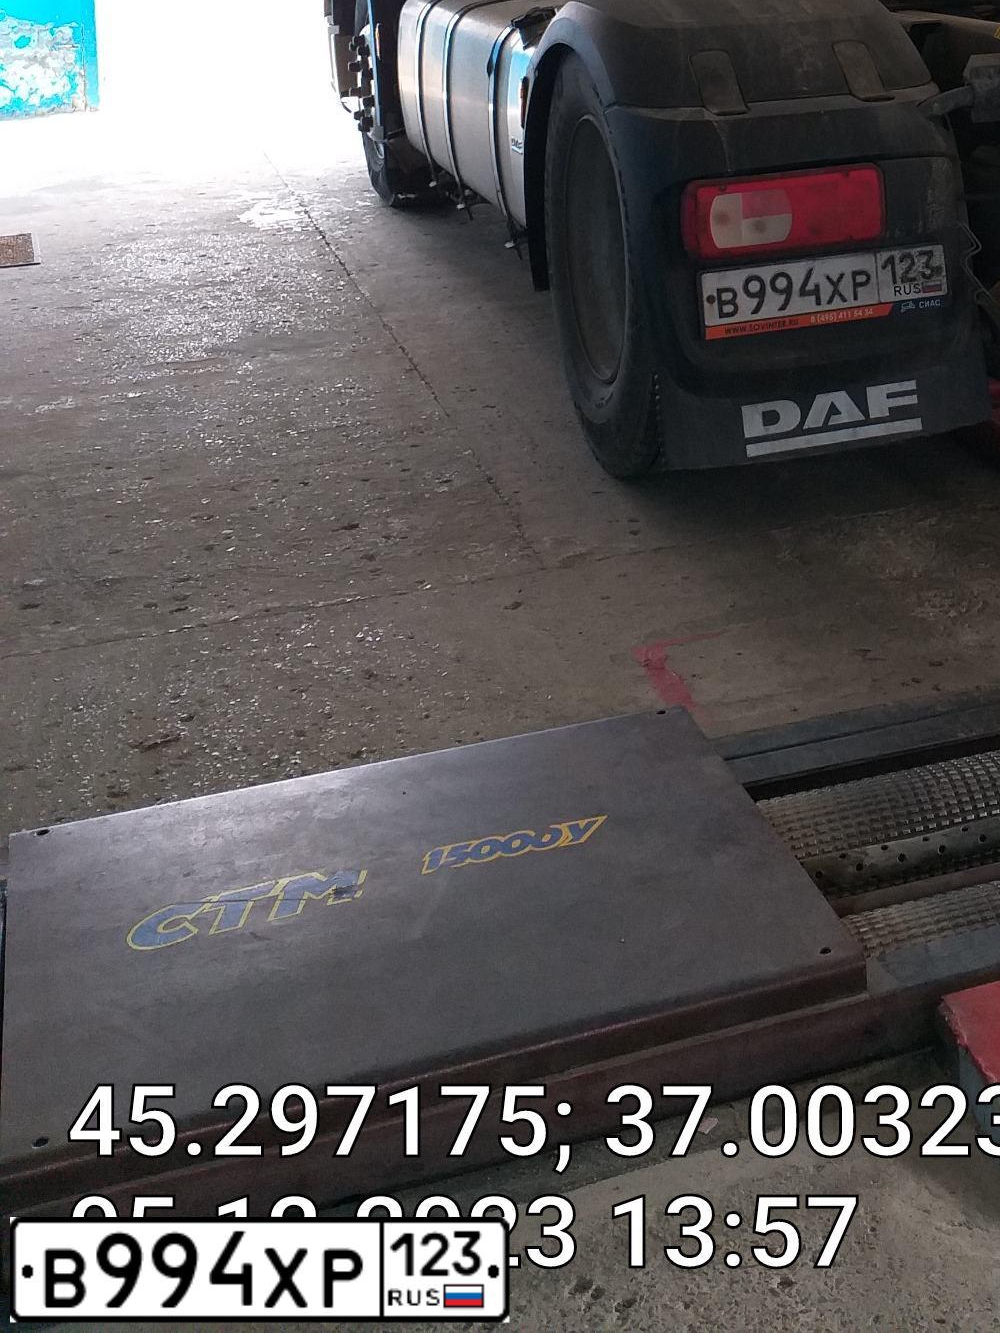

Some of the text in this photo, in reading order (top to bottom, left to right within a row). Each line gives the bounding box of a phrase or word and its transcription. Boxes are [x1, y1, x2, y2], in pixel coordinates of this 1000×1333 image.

[716, 250, 936, 319] В994ХР 123
[893, 283, 921, 297] RUS
[741, 380, 918, 439] DAF
